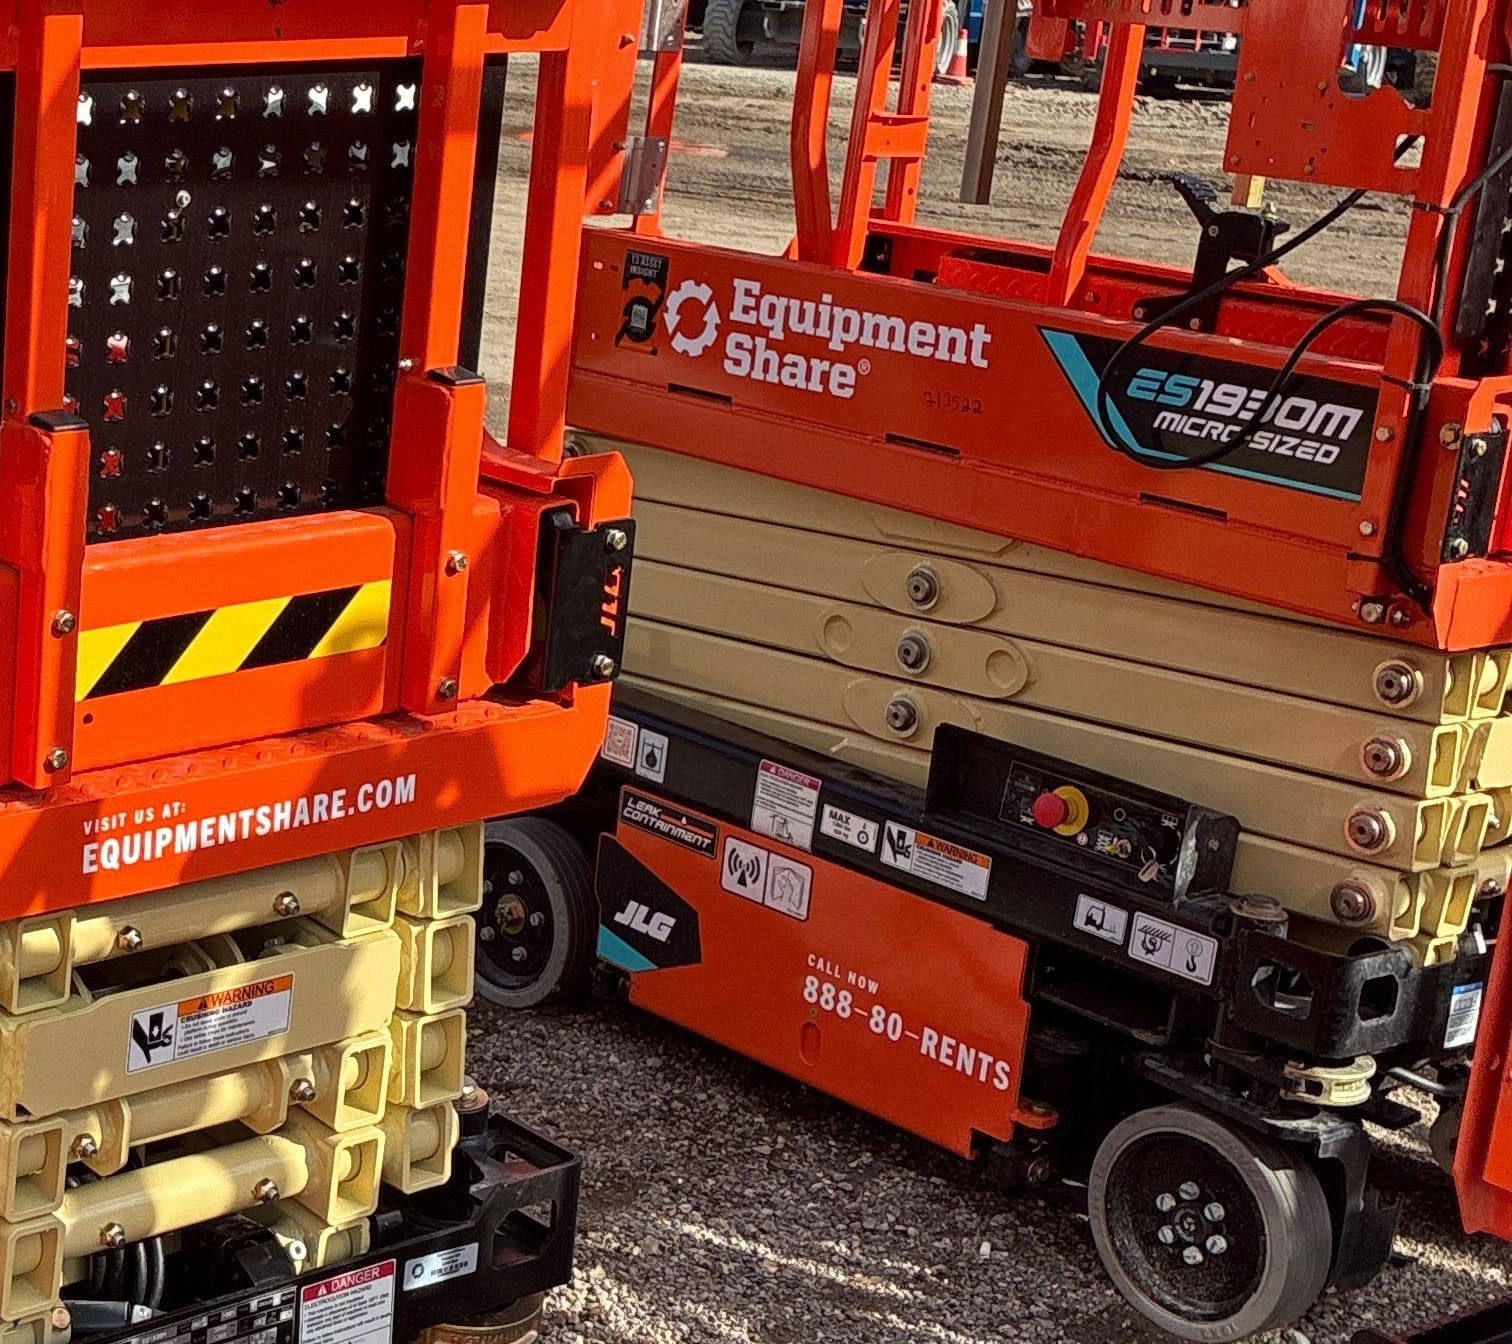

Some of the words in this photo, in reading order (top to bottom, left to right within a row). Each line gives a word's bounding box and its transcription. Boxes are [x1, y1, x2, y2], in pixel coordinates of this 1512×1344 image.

[729, 277, 992, 369] Equipment
[1126, 367, 1365, 441] ES1930M
[1152, 410, 1341, 465] MICRO-SIZED
[81, 773, 417, 874] EQUIPMENTSHARE.COM
[82, 811, 127, 836] VISIT
[133, 806, 155, 826] US
[160, 801, 186, 820] AT:
[622, 807, 712, 850] CONTAINMENT
[627, 796, 662, 818] LEAK
[829, 809, 851, 826] MAX
[613, 899, 677, 943] JLG
[211, 980, 276, 1007] WARNING
[807, 953, 842, 979] CALL
[847, 969, 880, 995] NOW
[802, 974, 1011, 1091] 888-80-RENTS
[331, 1266, 381, 1292] DANGER
